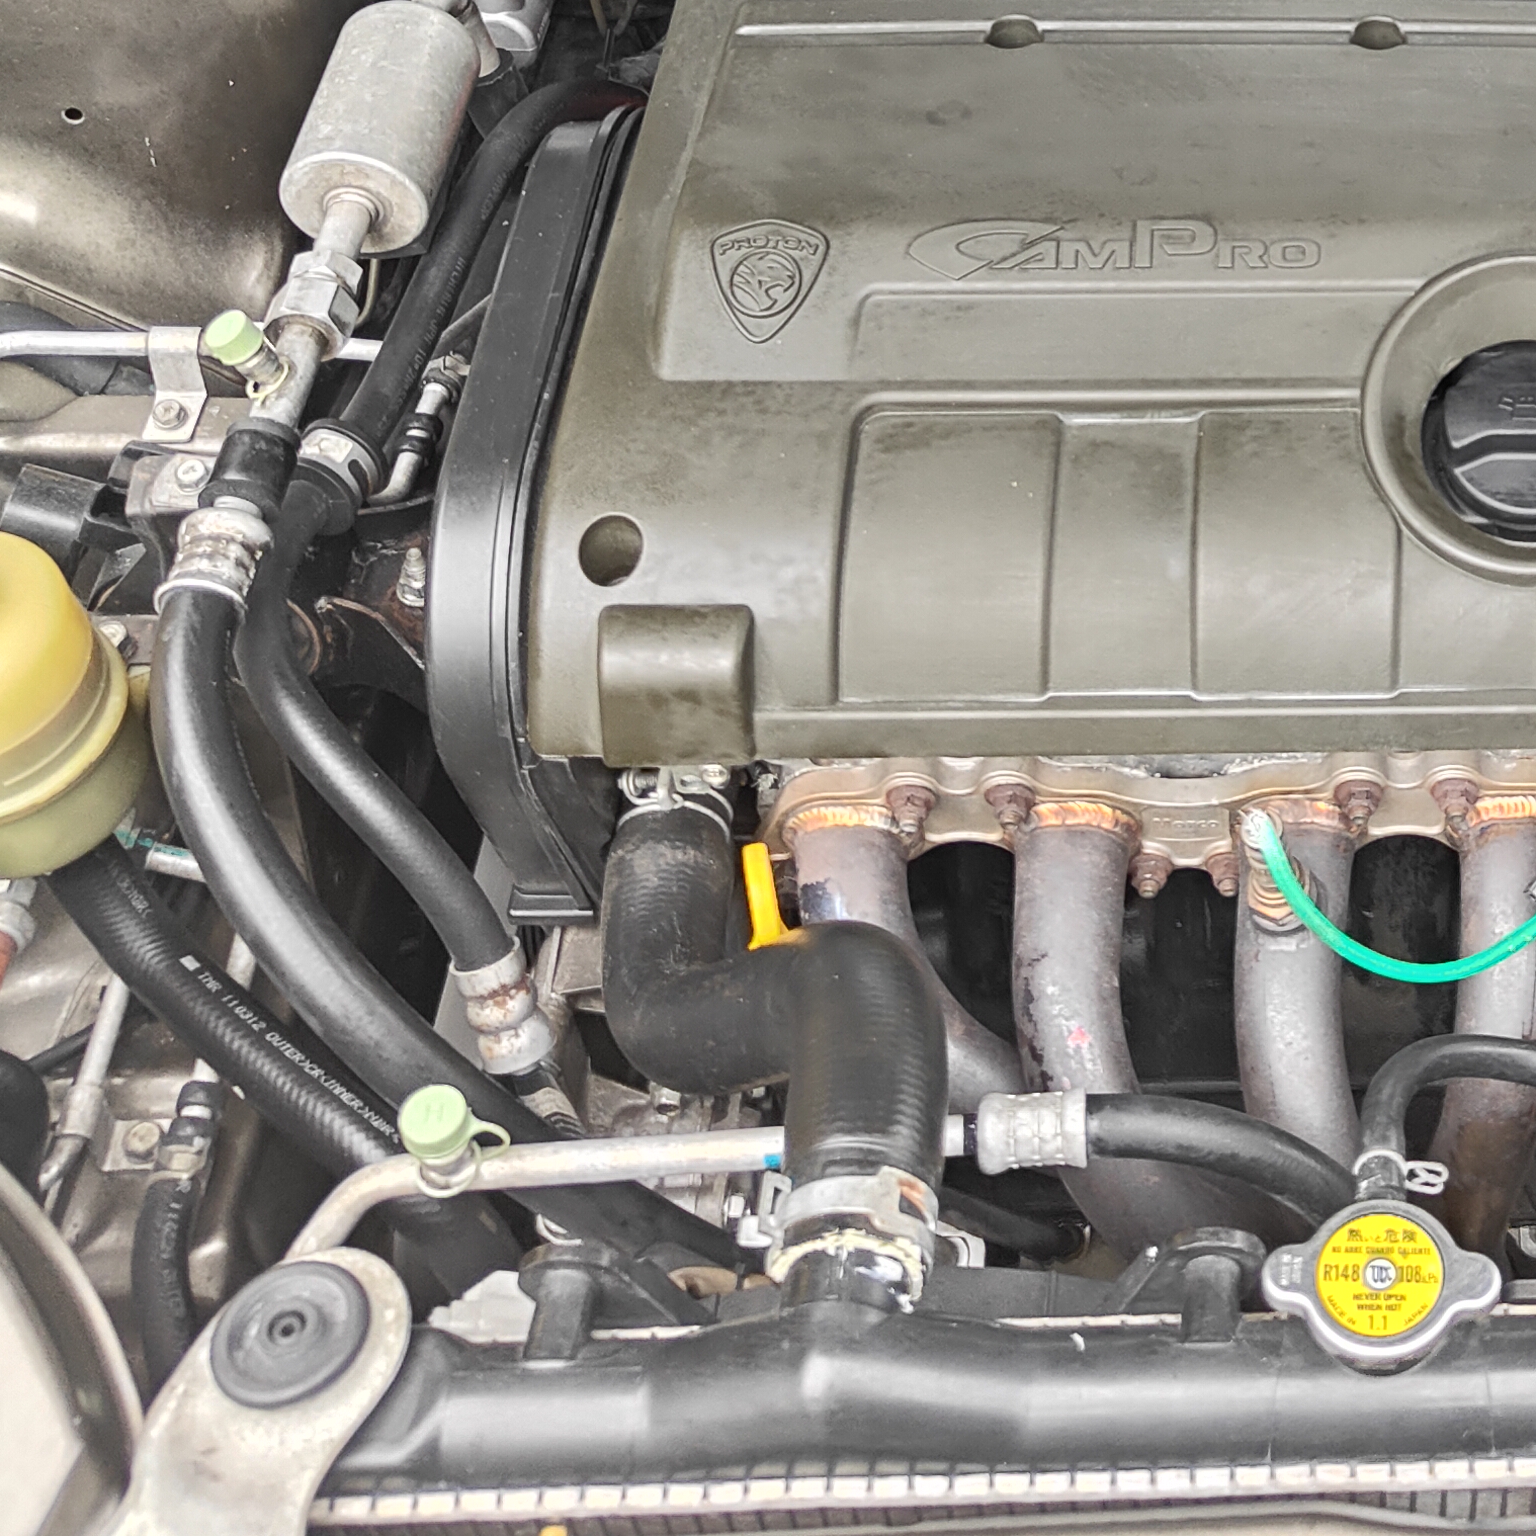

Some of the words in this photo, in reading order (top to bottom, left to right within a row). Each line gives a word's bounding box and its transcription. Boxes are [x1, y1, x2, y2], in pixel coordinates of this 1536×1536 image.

[719, 236, 820, 257] PROTON
[1323, 1263, 1360, 1282] R148
[1367, 1314, 1388, 1331] 1.1
